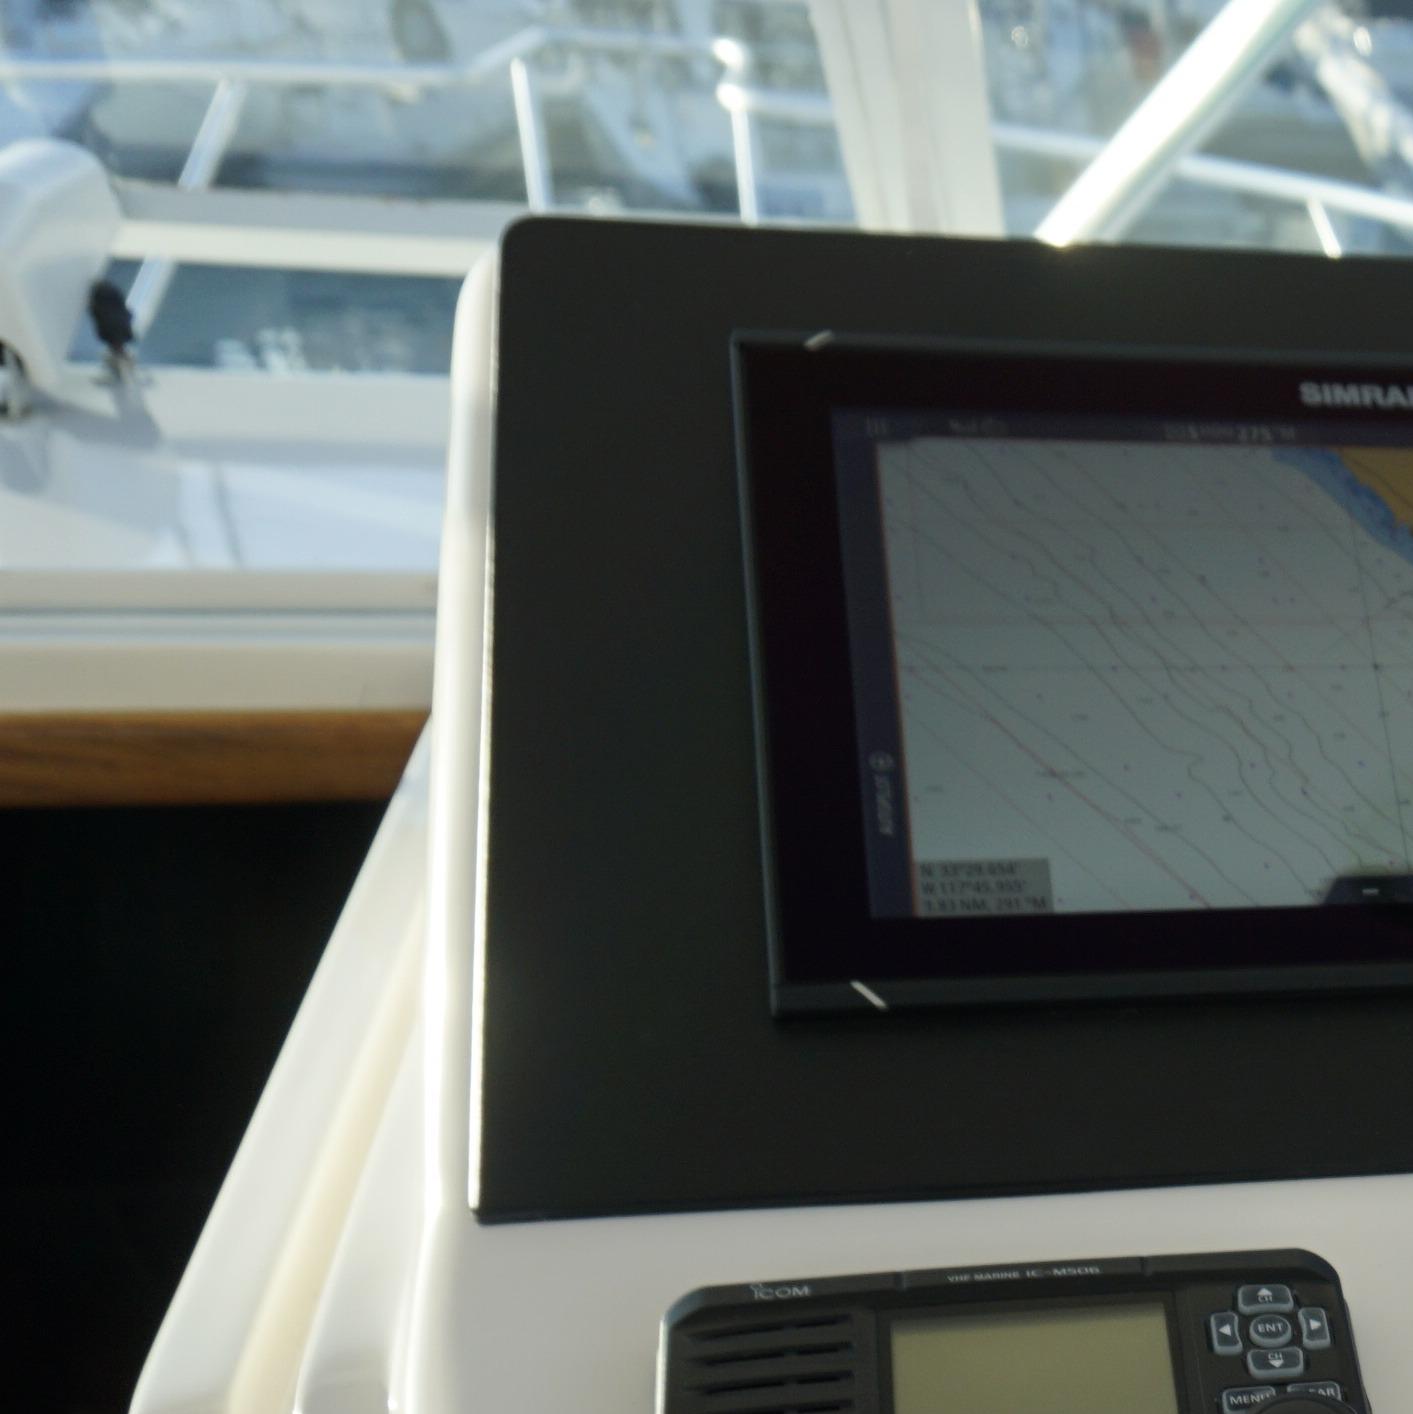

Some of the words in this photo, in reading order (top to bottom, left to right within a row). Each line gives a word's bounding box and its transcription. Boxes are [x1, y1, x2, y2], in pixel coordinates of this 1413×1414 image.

[947, 1274, 971, 1282] VHF
[974, 1270, 1020, 1281] MARINE
[1257, 1322, 1284, 1333] ENT
